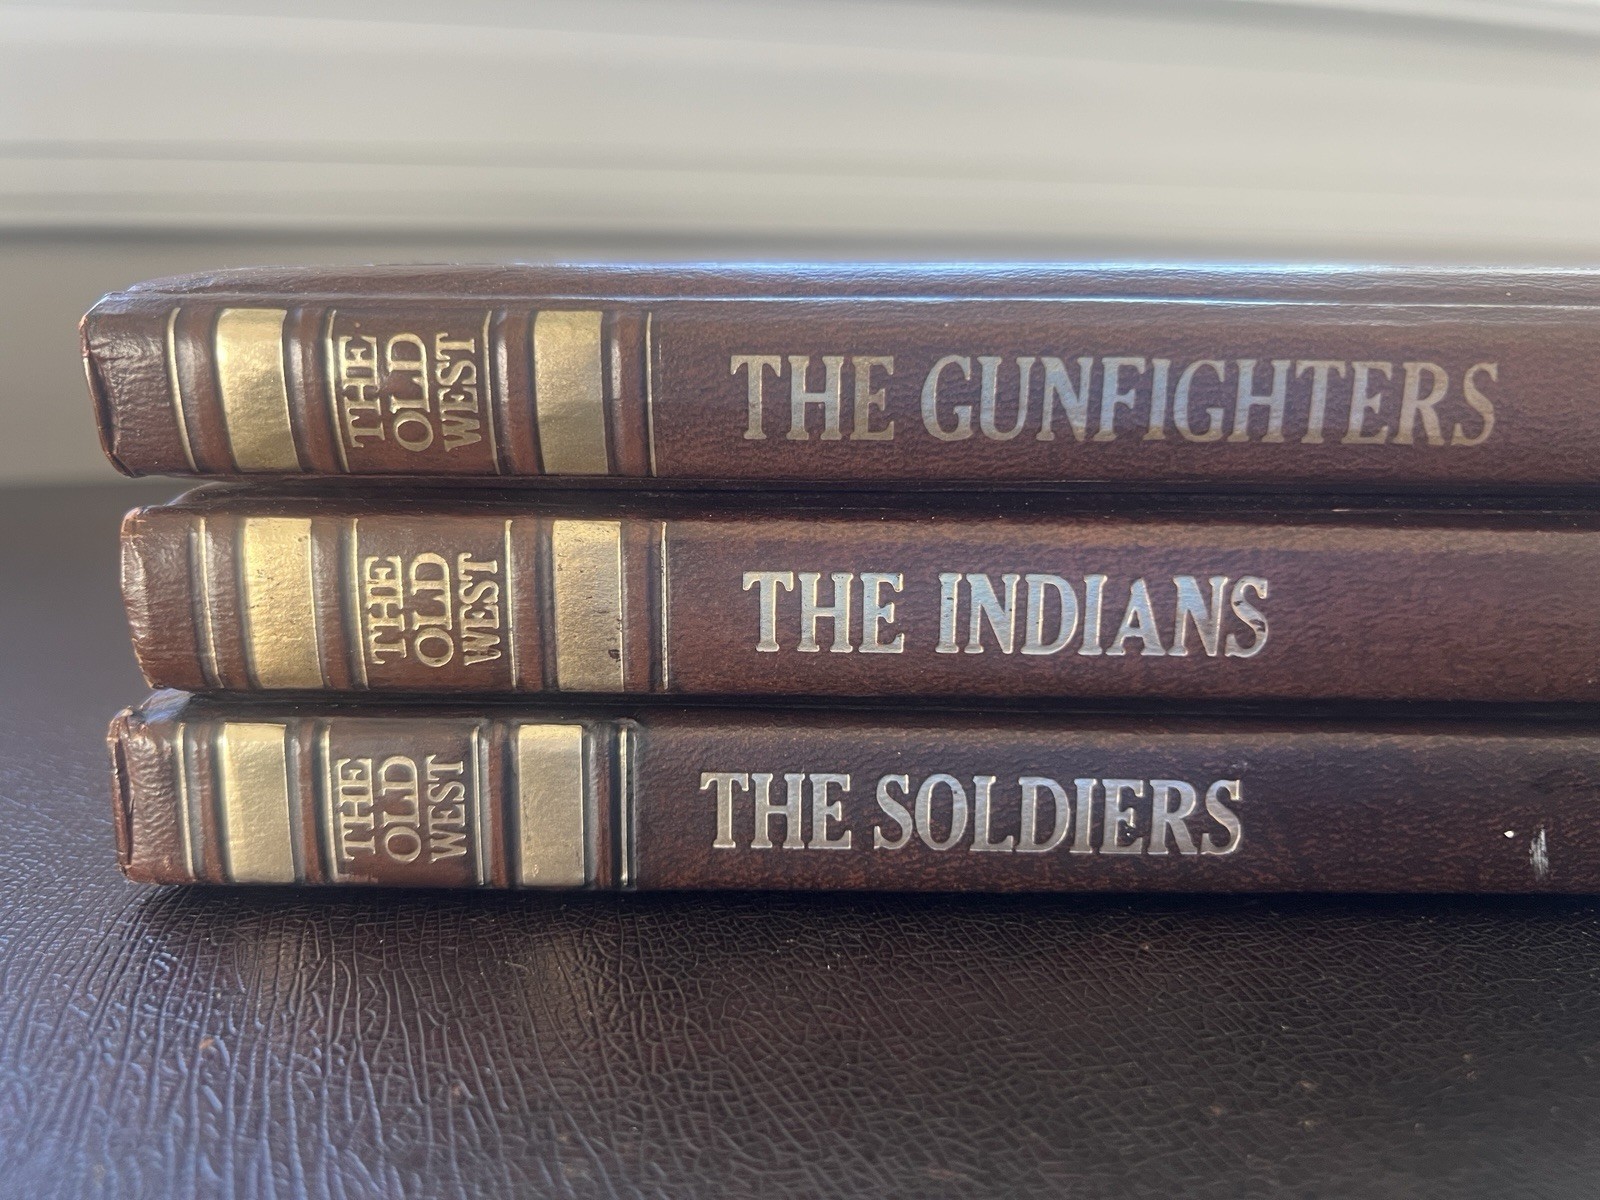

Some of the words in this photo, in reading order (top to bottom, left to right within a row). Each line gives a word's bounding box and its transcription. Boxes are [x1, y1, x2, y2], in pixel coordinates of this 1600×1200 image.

[339, 336, 385, 448] THE
[387, 333, 434, 451] OLD
[435, 333, 482, 452] WEST
[730, 354, 896, 443] THE
[921, 354, 1499, 448] GUNFIGHTERS
[365, 555, 407, 664] THE
[410, 552, 454, 667] OLD
[458, 552, 501, 666] WEST
[742, 571, 905, 653] THE
[935, 572, 1269, 658] INDIANS
[336, 758, 376, 861] THE
[379, 755, 422, 864] OLD
[426, 754, 467, 864] WEST
[700, 772, 852, 850] THE
[873, 773, 1244, 856] SOLDIERS
